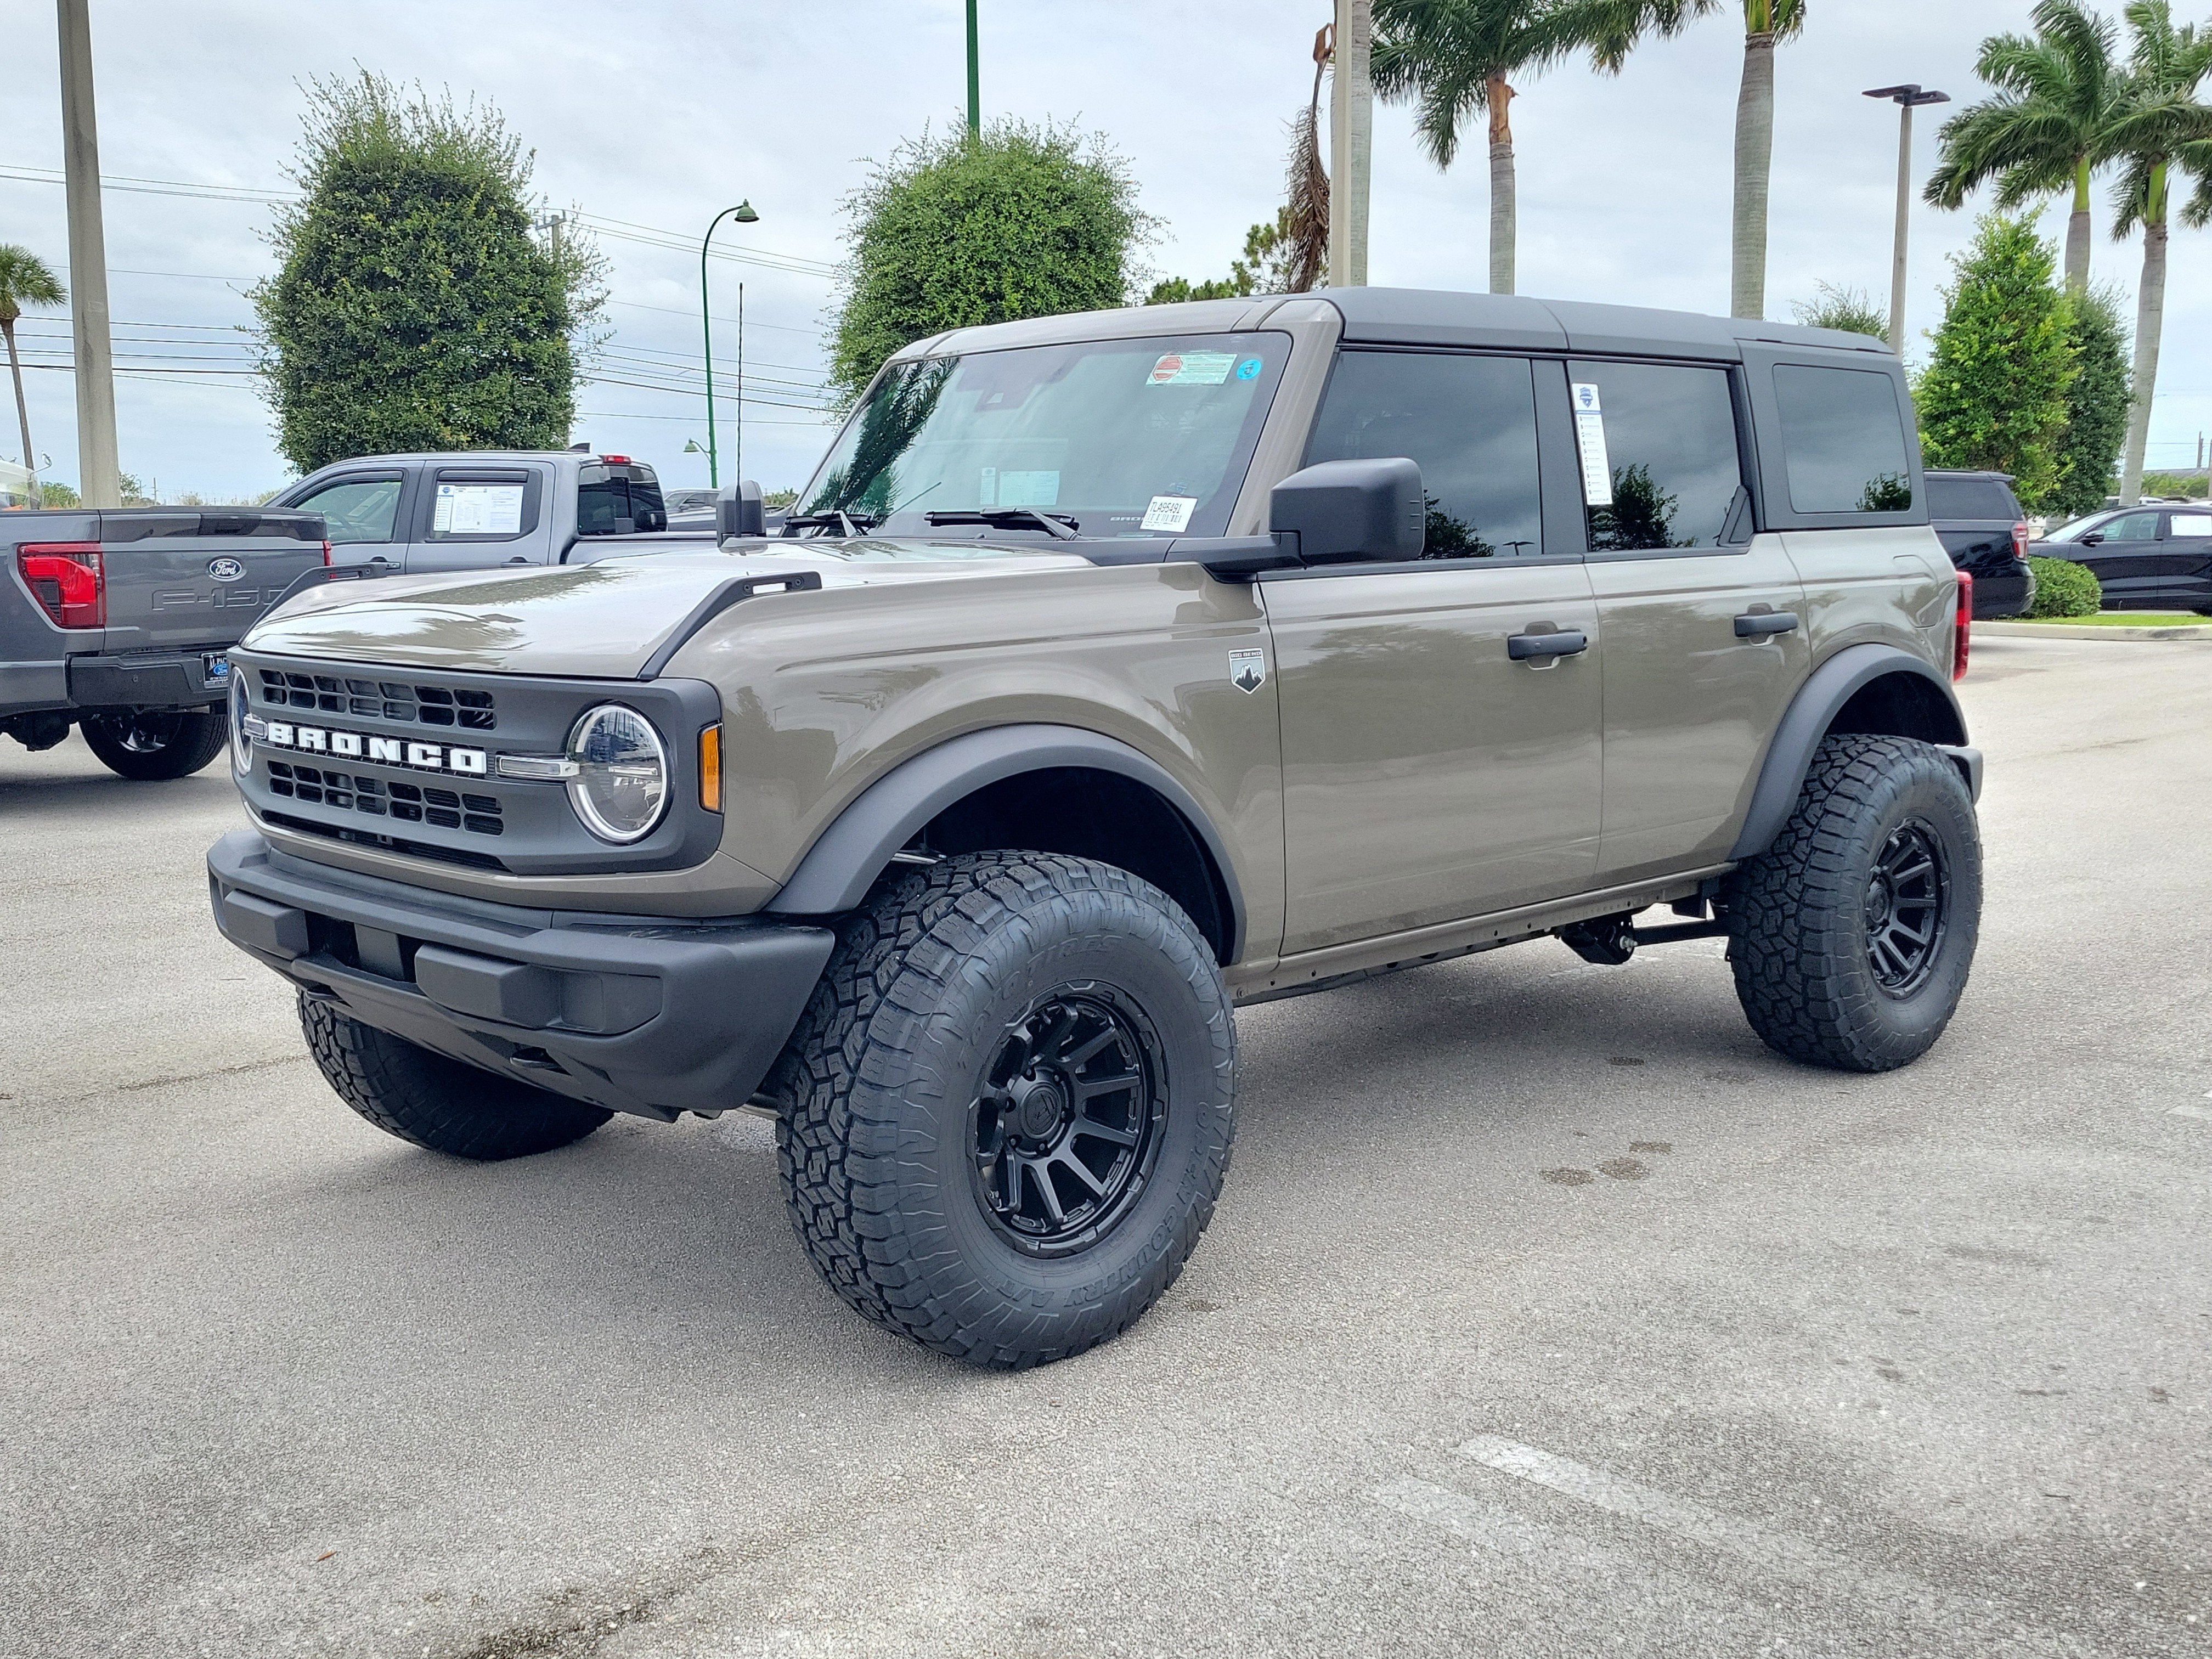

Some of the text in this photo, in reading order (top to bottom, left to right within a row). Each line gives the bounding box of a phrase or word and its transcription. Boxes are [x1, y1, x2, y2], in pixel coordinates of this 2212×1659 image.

[1150, 501, 1182, 514] TLA95491
[215, 561, 237, 575] Ford
[217, 657, 227, 665] PAC
[268, 722, 487, 774] BRONCO
[1025, 934, 1124, 978] TIRES
[1176, 1102, 1210, 1205] OPEN
[1063, 1205, 1178, 1307] COUNTRY
